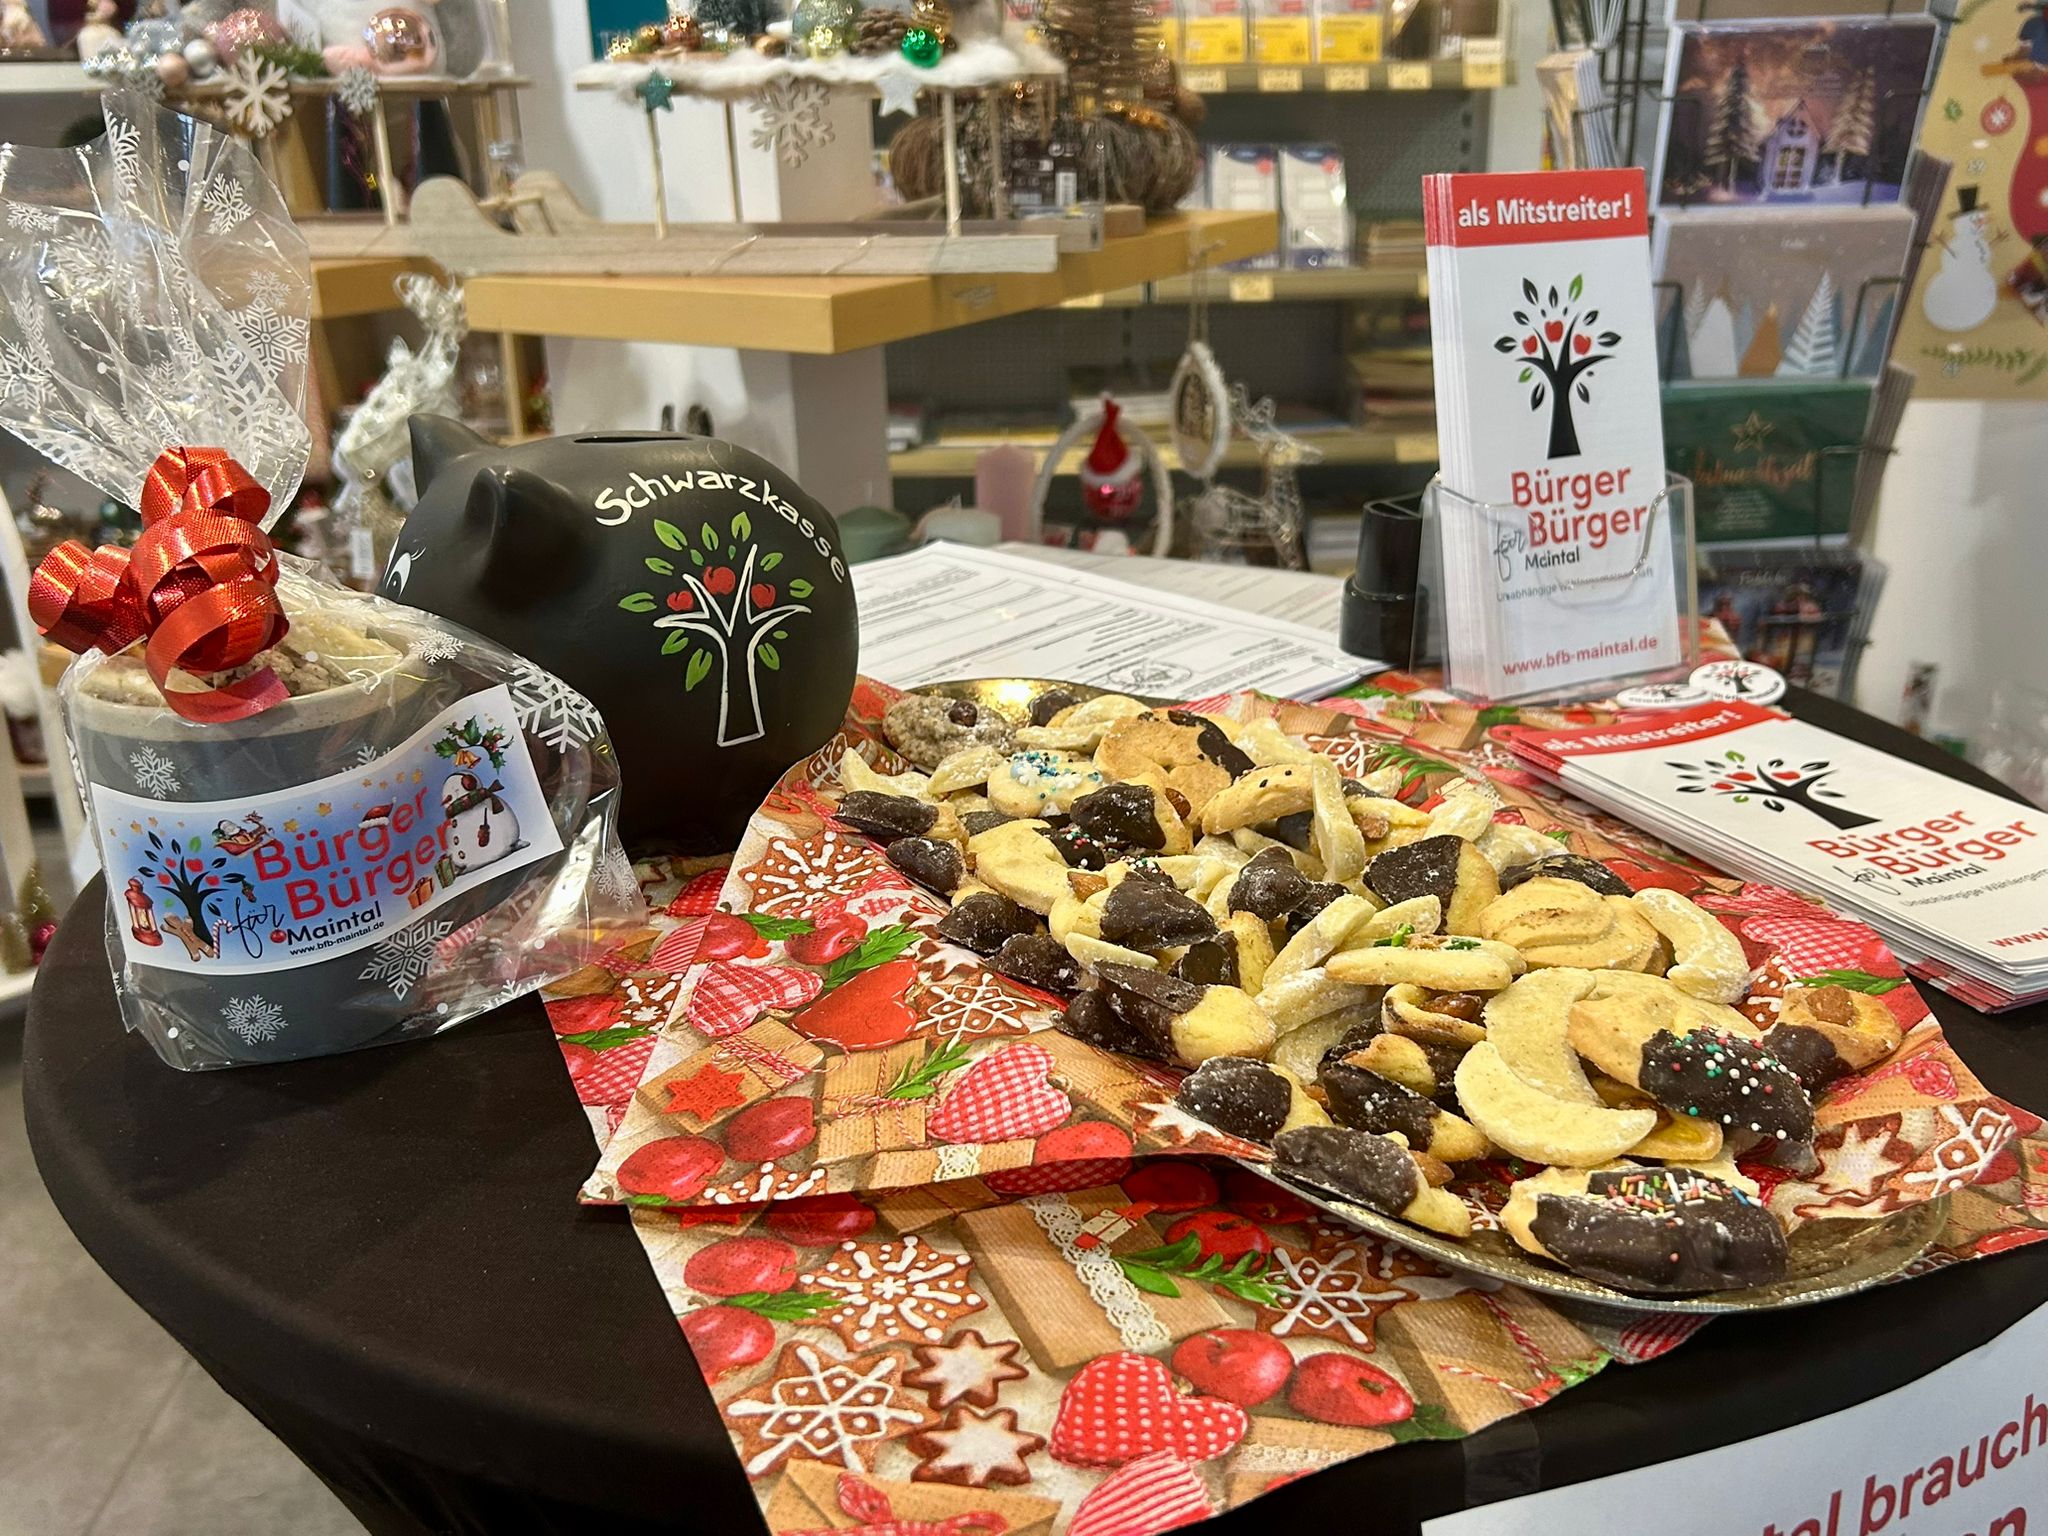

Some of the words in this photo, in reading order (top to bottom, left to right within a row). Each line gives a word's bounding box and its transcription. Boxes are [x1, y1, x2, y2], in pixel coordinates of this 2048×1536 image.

[1458, 199, 1490, 227] als
[1496, 193, 1633, 225] Mitstreiter!
[1511, 467, 1631, 509] Bürger
[594, 470, 846, 584] Schwarzkasse
[1493, 520, 1526, 582] für
[1526, 505, 1649, 549] Bürger
[1524, 545, 1580, 570] Maintal
[1503, 635, 1658, 676] www.bfb-maintal.de
[1541, 737, 1584, 752] als
[1581, 710, 1744, 749] Mitstreiter!
[252, 786, 429, 882] Bürger
[1805, 809, 1976, 859] Bürger
[1865, 819, 2038, 876] Bürger
[233, 896, 285, 959] für
[285, 818, 453, 921] Bürger
[1902, 862, 1989, 888] Maintal
[287, 901, 383, 946] Maintal
[289, 920, 385, 956] www.bfb-maintal.de
